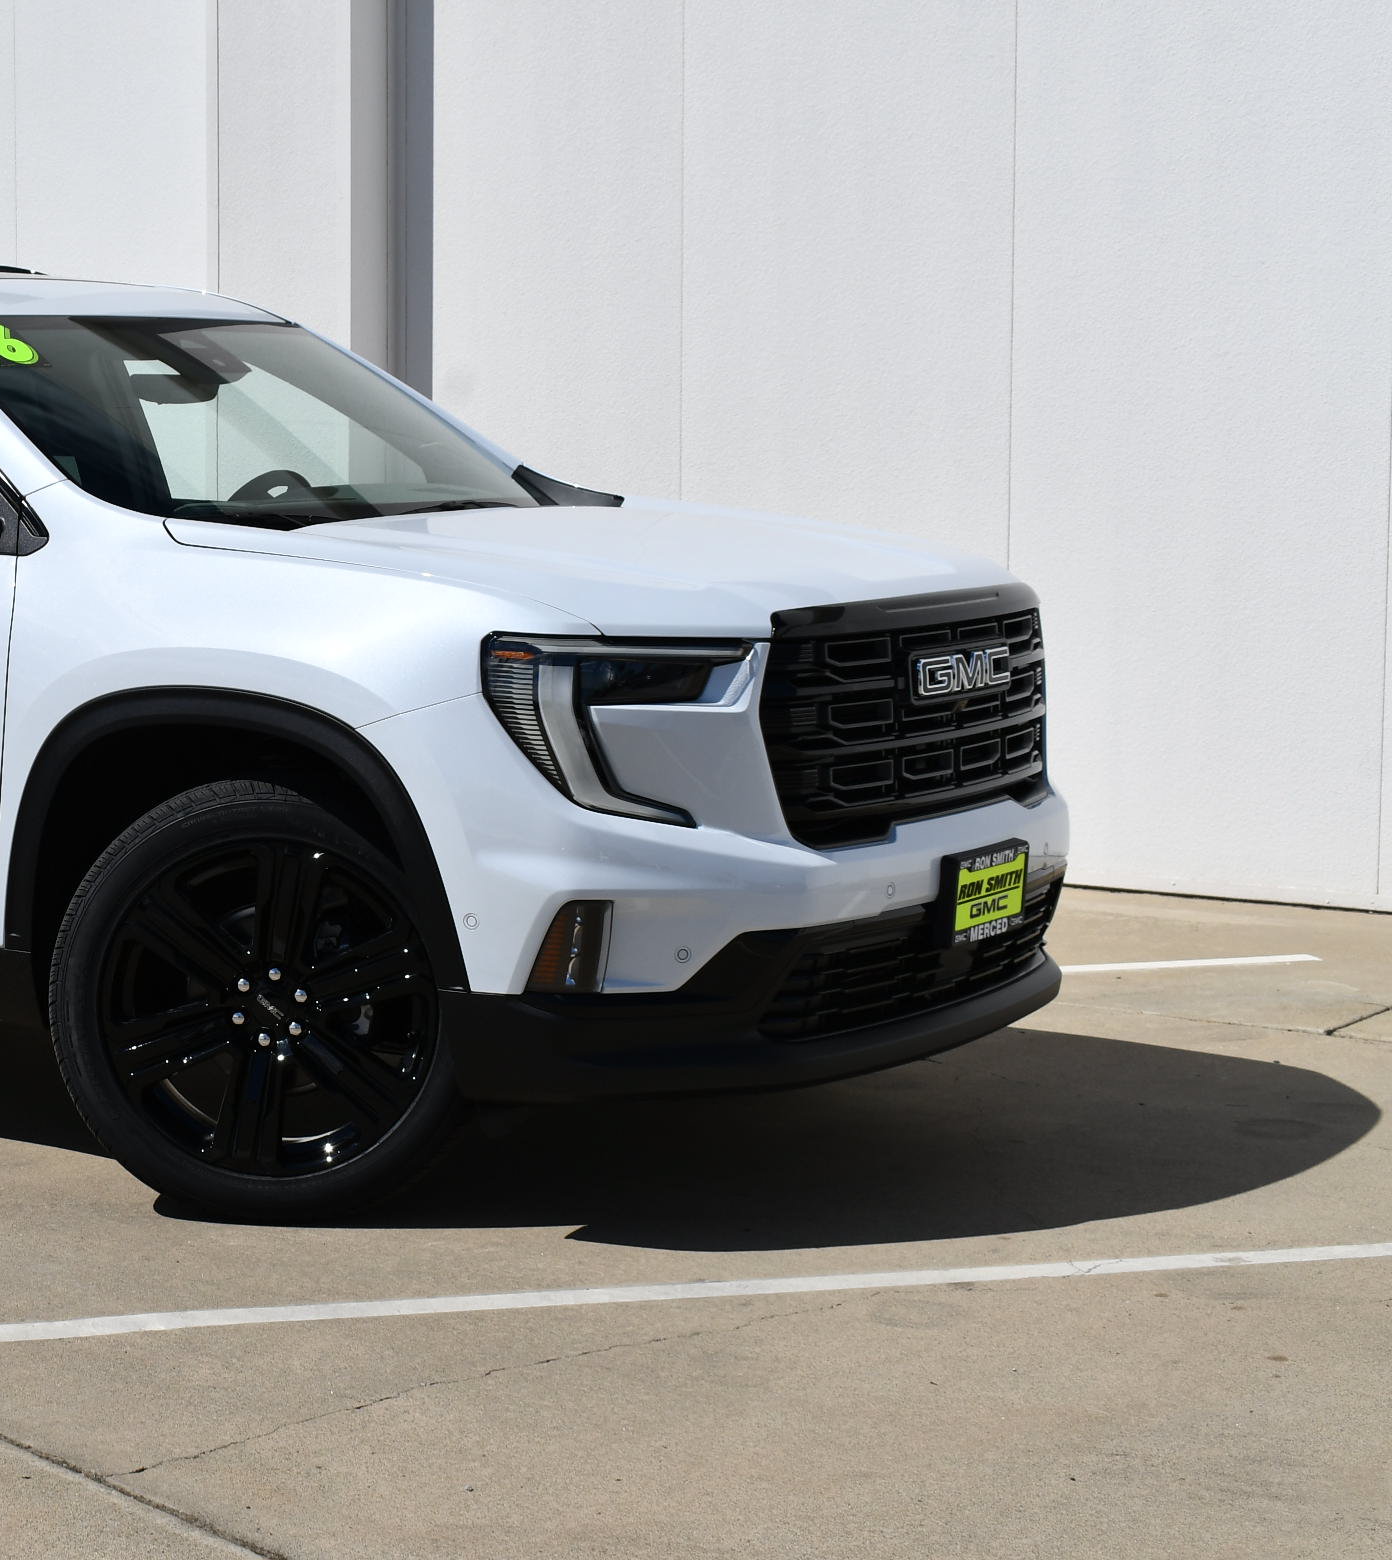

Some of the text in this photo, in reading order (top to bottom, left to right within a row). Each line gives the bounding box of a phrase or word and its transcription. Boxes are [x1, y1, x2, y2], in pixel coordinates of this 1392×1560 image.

[917, 646, 1011, 696] GMC
[974, 855, 991, 870] RON
[992, 849, 1015, 866] SMITH
[958, 869, 1024, 901] RON SMITH
[969, 895, 1009, 919] GMC
[970, 917, 1009, 942] MERCED
